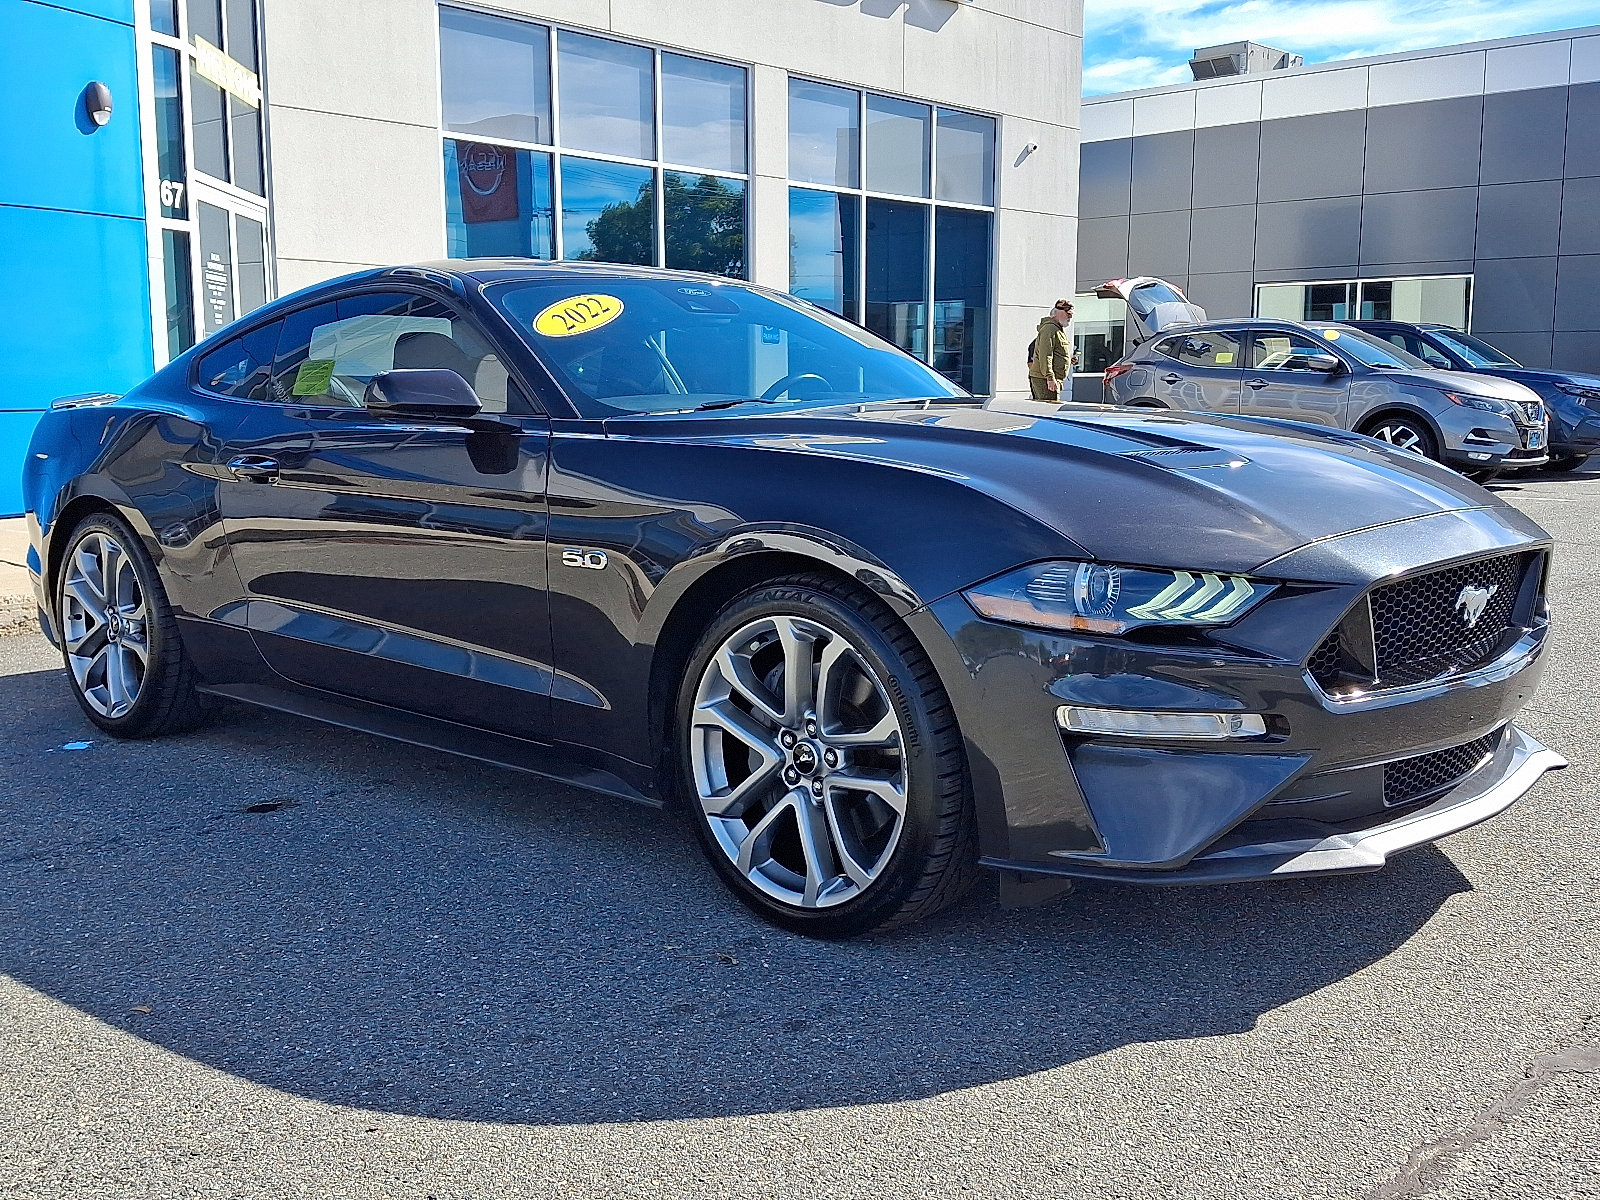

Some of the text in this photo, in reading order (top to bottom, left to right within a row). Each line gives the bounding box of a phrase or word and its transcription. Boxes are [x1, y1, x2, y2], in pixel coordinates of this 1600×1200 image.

[160, 179, 184, 209] 67
[552, 298, 610, 331] 2022
[562, 547, 608, 570] 5.0
[887, 674, 921, 748] Continental
